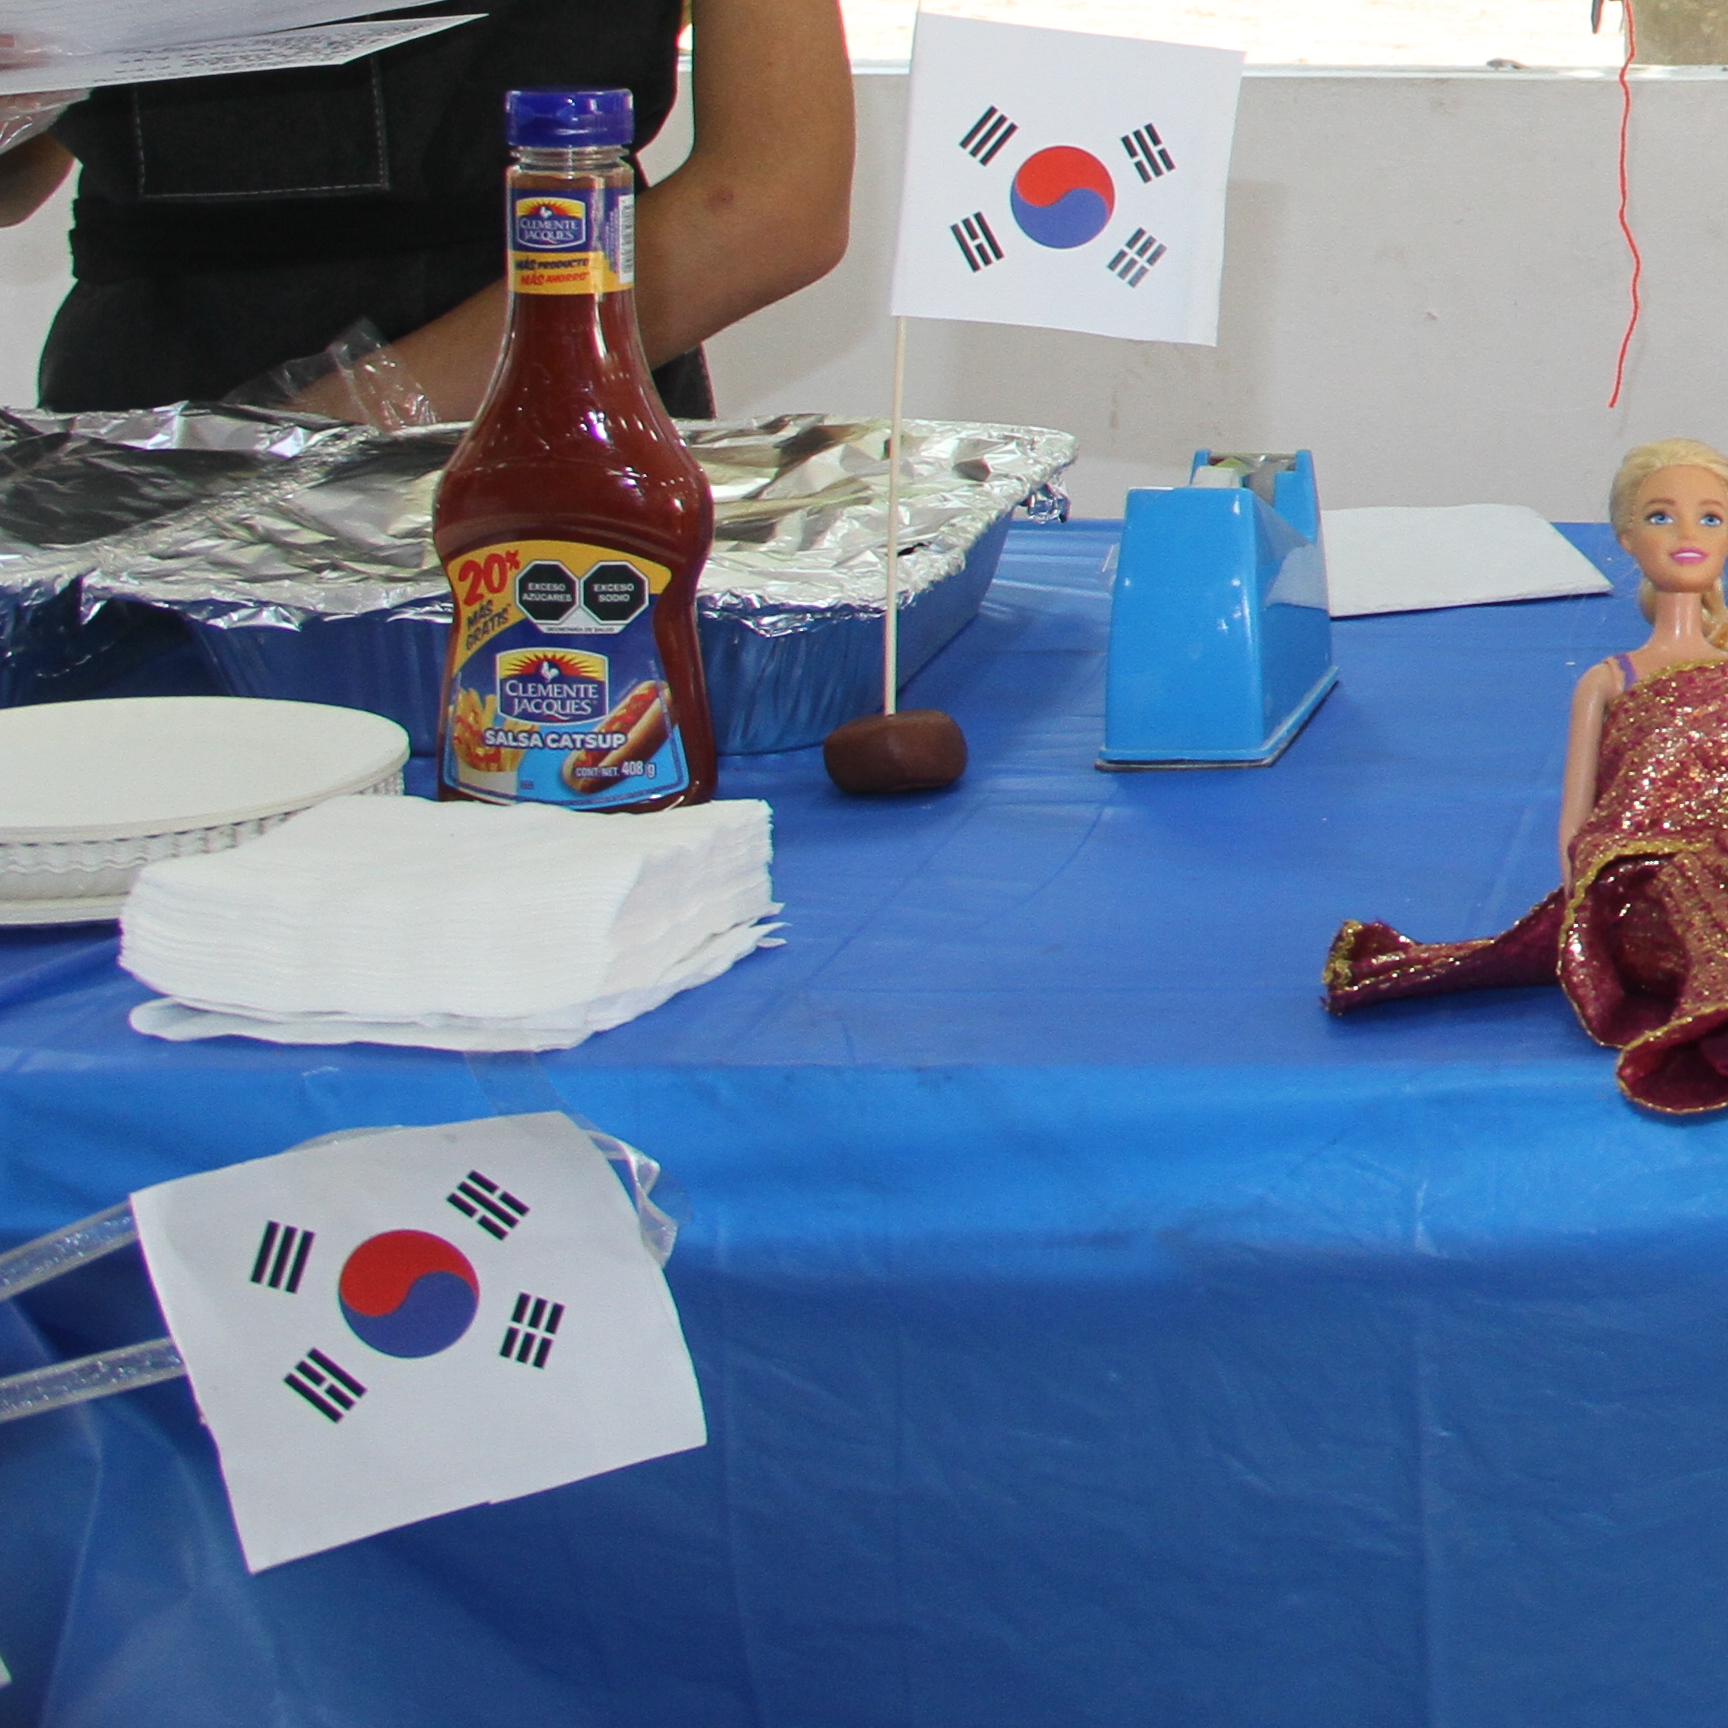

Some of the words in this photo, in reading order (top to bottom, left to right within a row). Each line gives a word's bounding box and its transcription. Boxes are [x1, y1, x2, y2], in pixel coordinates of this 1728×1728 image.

[520, 218, 579, 230] CLEMENTE
[524, 229, 575, 244] JACQUES
[527, 582, 566, 592] EXCESO
[592, 582, 635, 593] EXCESO
[597, 593, 631, 603] SODIO
[505, 679, 599, 699] CLEMENTE
[512, 698, 594, 721] JACQUES
[483, 729, 542, 748] SALSA
[545, 731, 628, 750] CATSUP
[621, 760, 644, 776] 408
[646, 763, 656, 779] g
